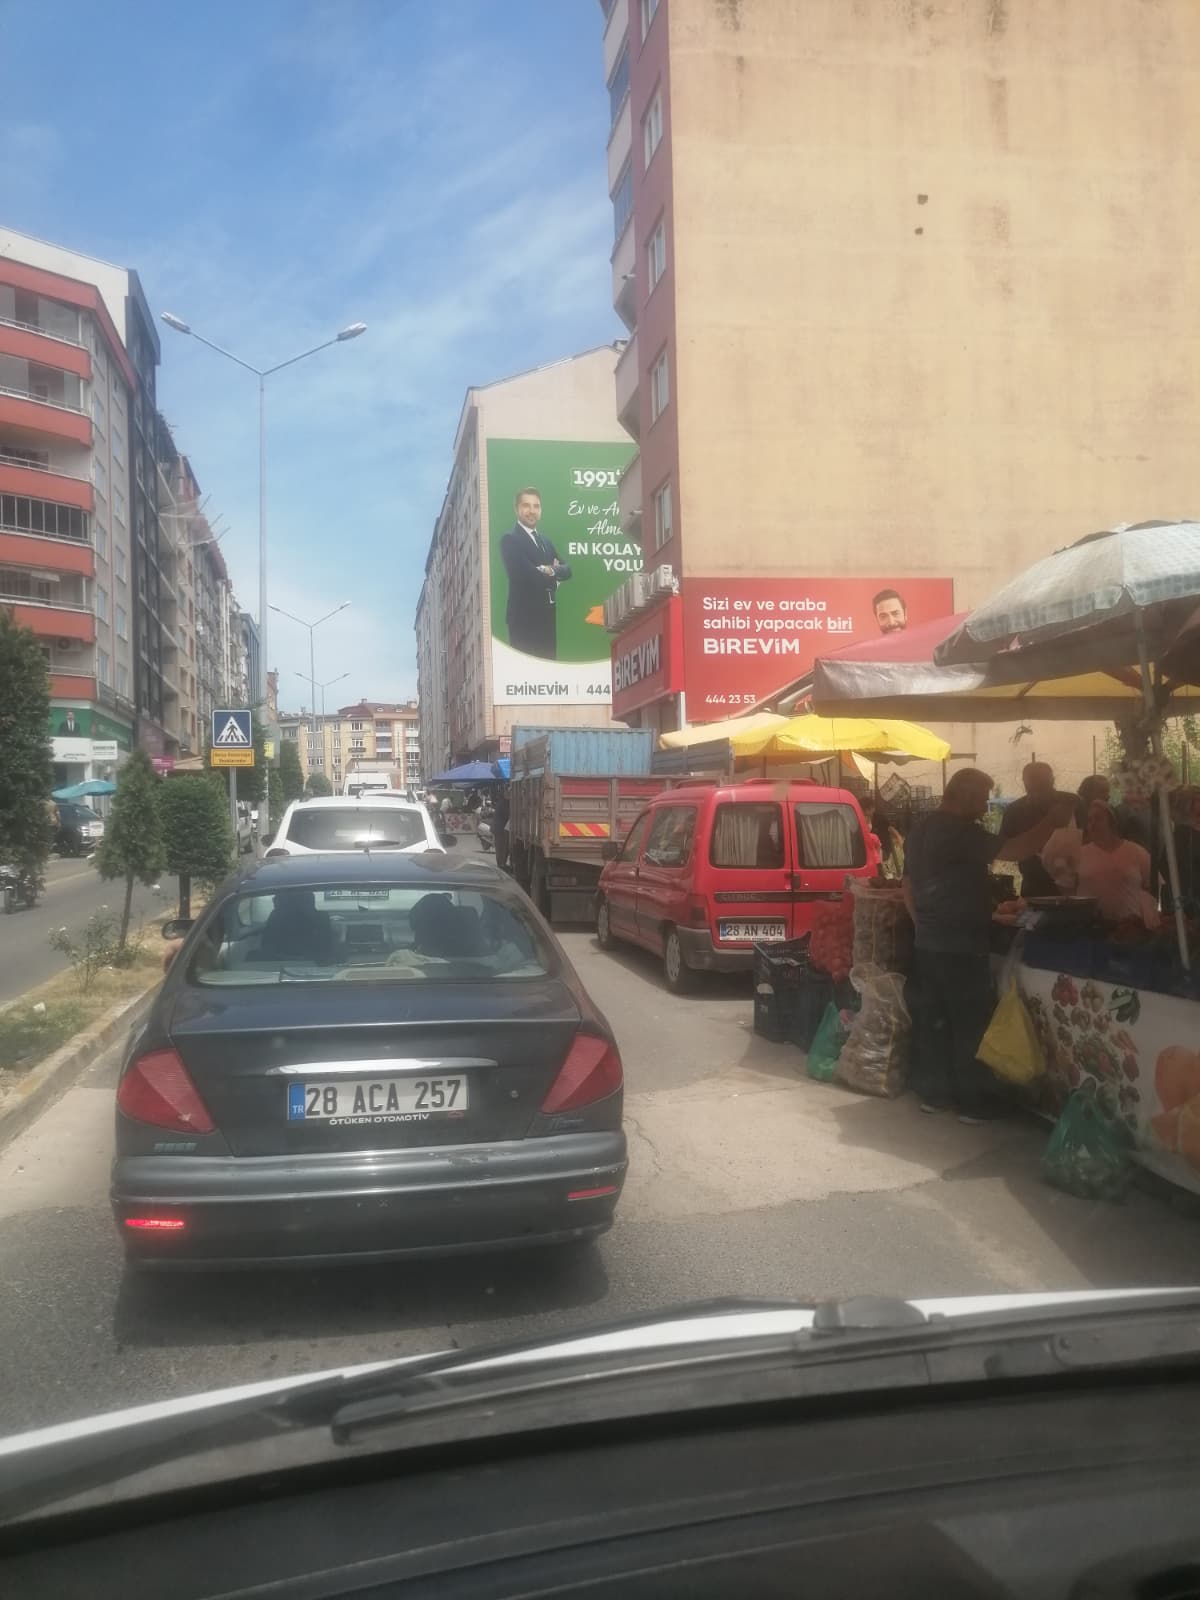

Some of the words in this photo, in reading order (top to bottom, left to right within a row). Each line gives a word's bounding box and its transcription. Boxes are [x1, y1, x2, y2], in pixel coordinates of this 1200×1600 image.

[568, 500, 585, 515] Ev
[587, 505, 600, 515] ve
[568, 542, 589, 555] EN
[592, 542, 642, 556] KOLAY
[603, 558, 644, 572] YOLU
[703, 597, 729, 610] Sizi
[733, 600, 752, 610] ev
[756, 600, 775, 610] ve
[779, 598, 827, 611] araba
[703, 616, 750, 629] sahibi
[755, 617, 823, 632] yapacak
[826, 617, 853, 632] biri
[506, 681, 569, 696] EMİNEVİM
[586, 684, 611, 696] 444
[705, 694, 726, 704] 444
[728, 694, 741, 704] 23
[743, 694, 756, 704] 53
[726, 925, 740, 936] 28
[743, 925, 759, 936] AN
[762, 924, 783, 936] 404
[292, 1105, 304, 1114] TR
[306, 1086, 338, 1116] 28
[352, 1082, 400, 1114] ACA
[414, 1079, 461, 1110] 257
[329, 1115, 372, 1127] ÖTÜKEN
[373, 1112, 430, 1124] OTOMOTİV
